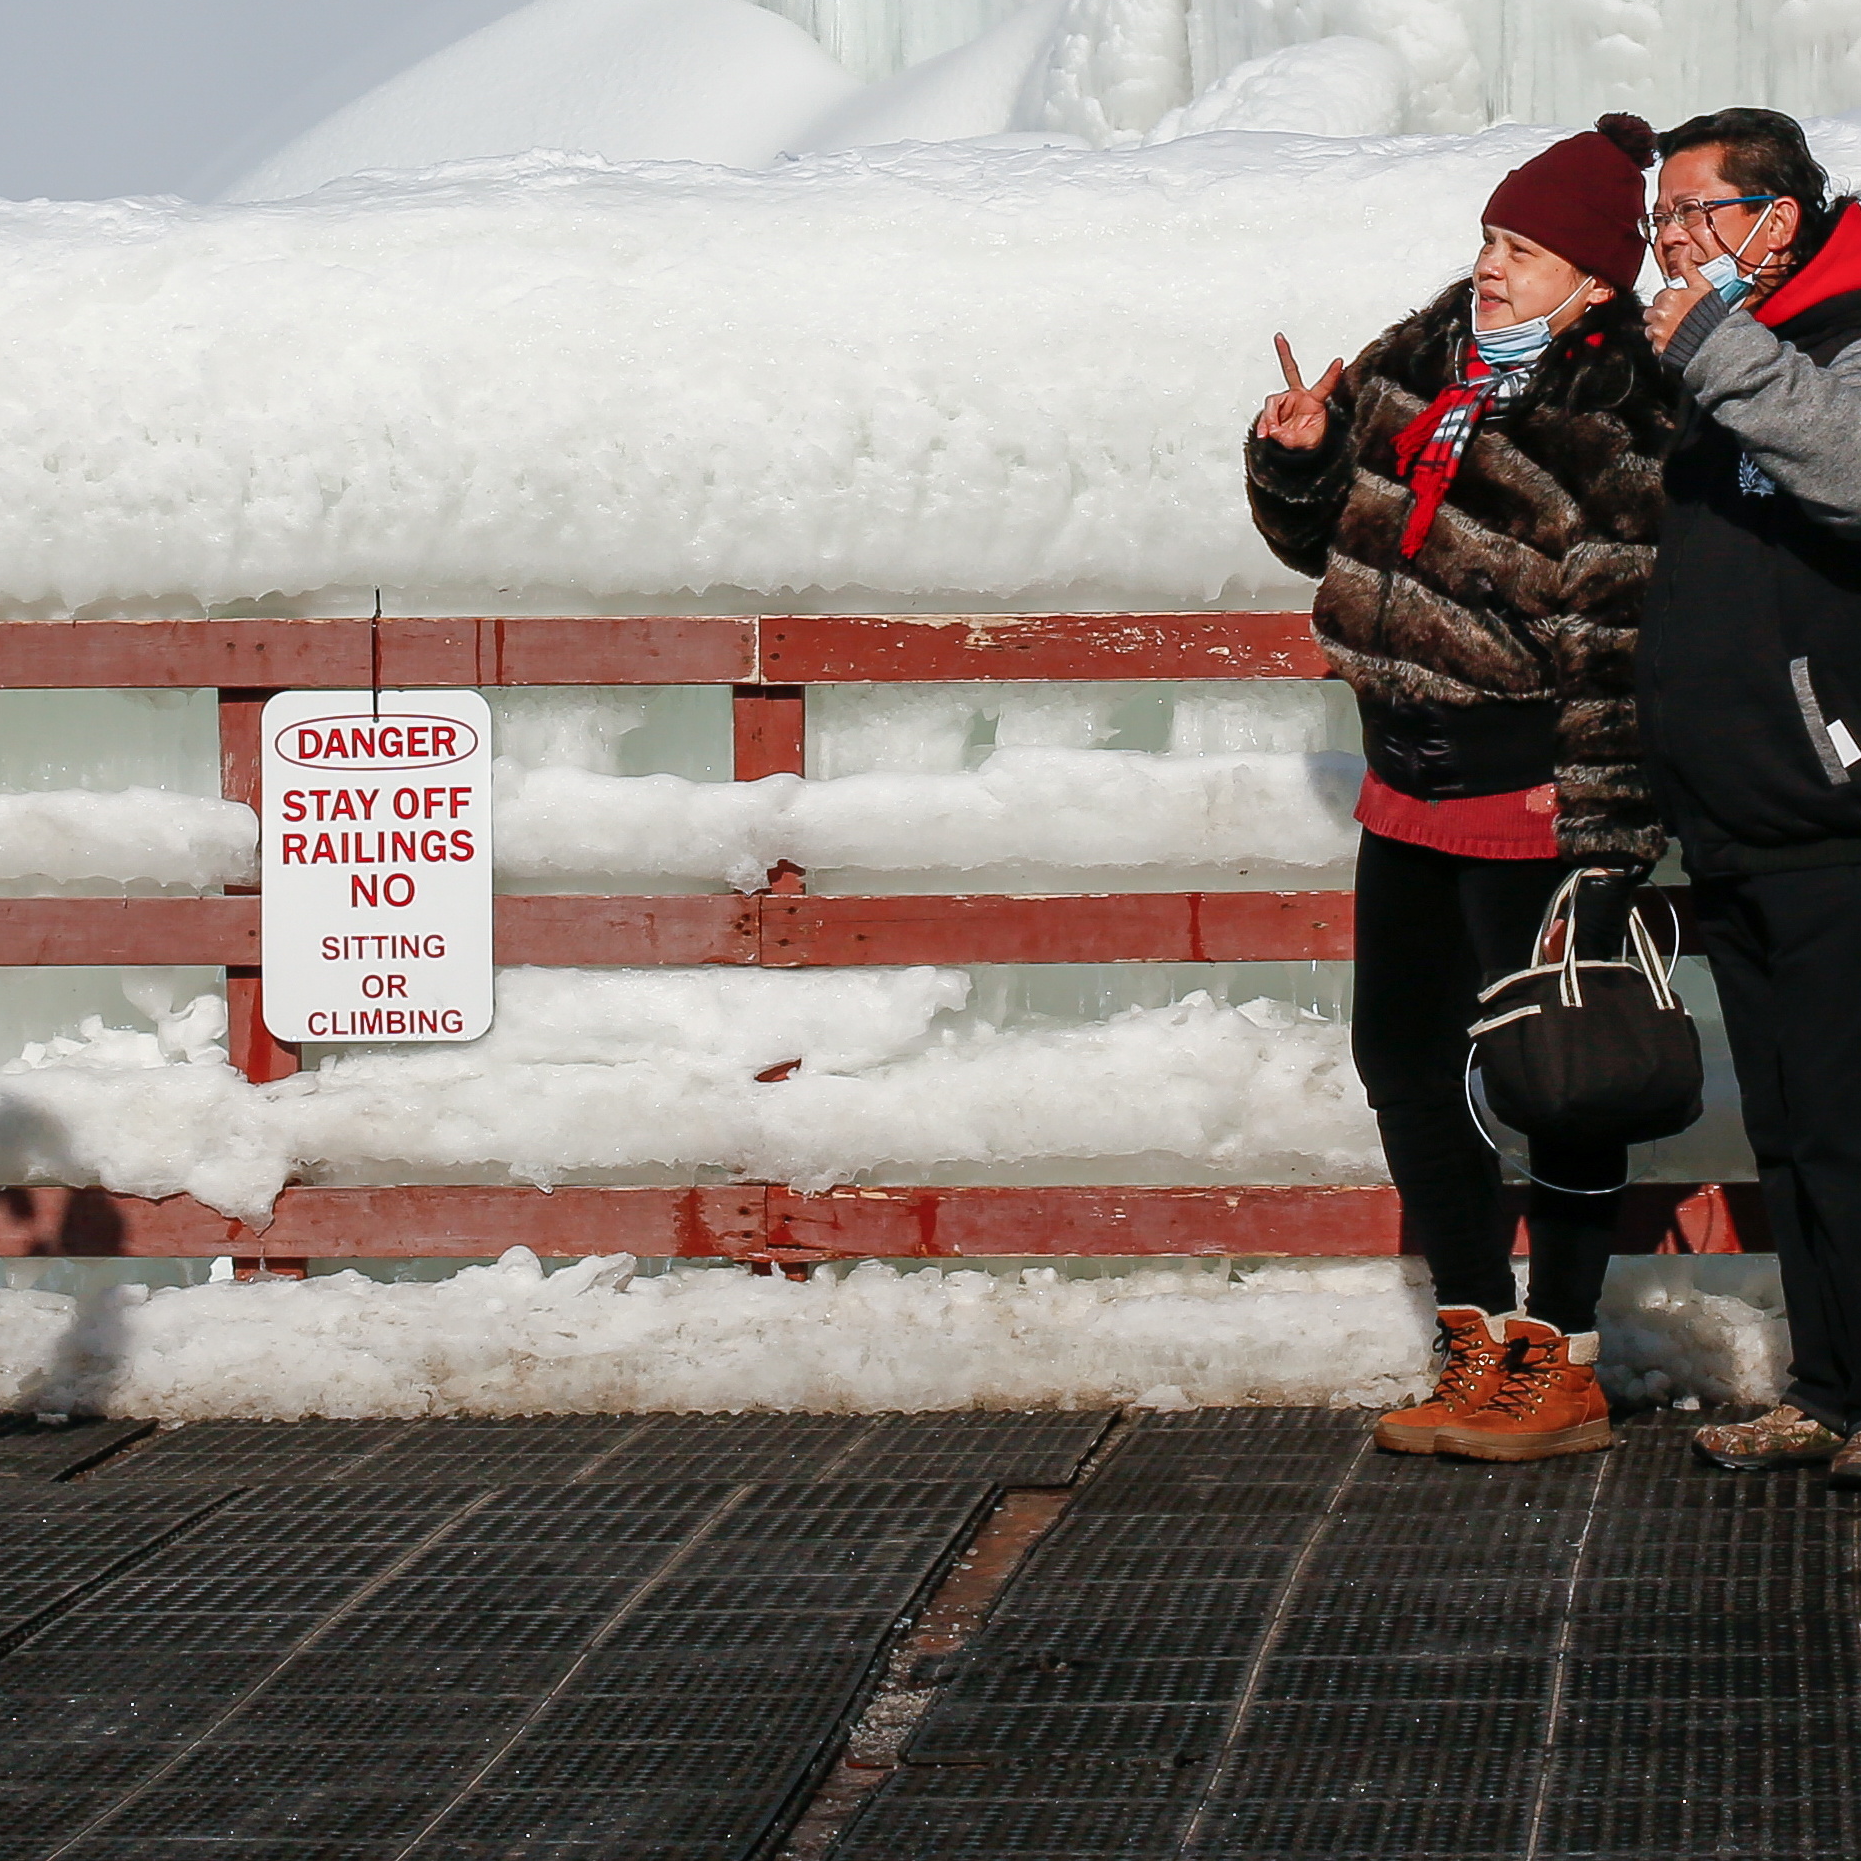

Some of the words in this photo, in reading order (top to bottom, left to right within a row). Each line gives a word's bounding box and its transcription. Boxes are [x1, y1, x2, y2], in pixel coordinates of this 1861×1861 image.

[298, 726, 457, 760] DANGER
[282, 789, 380, 822] STAY
[393, 787, 472, 820] OFF
[283, 829, 475, 864] RAILINGS
[351, 873, 415, 908] NO
[321, 935, 445, 960] SITTING
[361, 974, 408, 998] OR
[307, 1009, 464, 1036] CLIMBING
